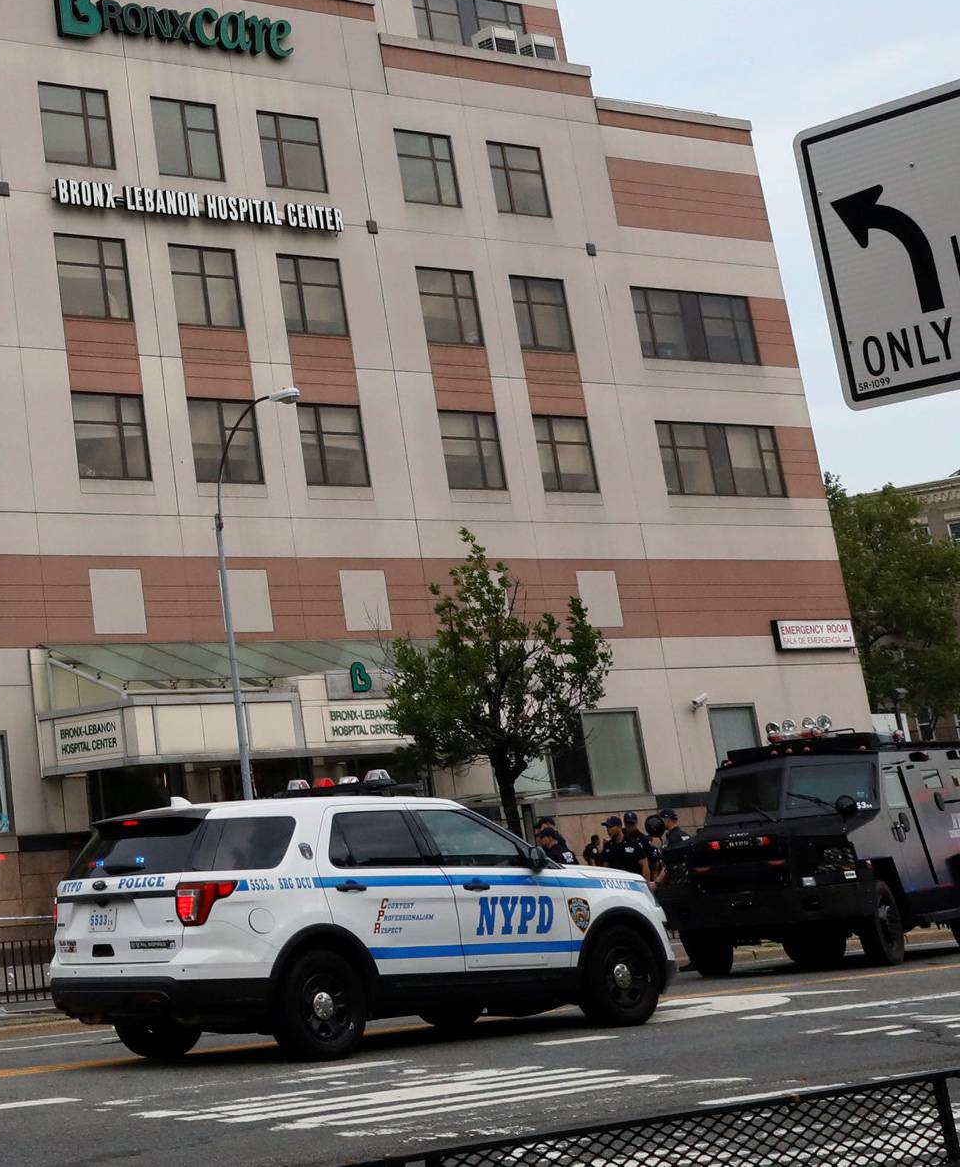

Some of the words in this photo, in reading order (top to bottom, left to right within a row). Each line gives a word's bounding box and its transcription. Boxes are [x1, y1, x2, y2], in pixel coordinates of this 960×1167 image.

[56, 179, 200, 217] BRONX-LEBANON
[206, 194, 283, 226] HOSPITAL
[287, 203, 345, 232] CENTER
[862, 317, 952, 376] ONLY
[858, 376, 890, 392] SR-1099
[781, 624, 824, 635] EMERGENCY
[827, 624, 848, 633] ROOM
[60, 721, 116, 739] BRONX-LEBANON
[332, 725, 369, 736] HOSPITAL
[61, 741, 91, 755] HOSPITAL
[91, 737, 118, 751] CENTER
[62, 881, 83, 893] NYPD
[118, 876, 166, 889] POLICE
[599, 878, 631, 890] POLICE
[476, 895, 554, 936] NYPD
